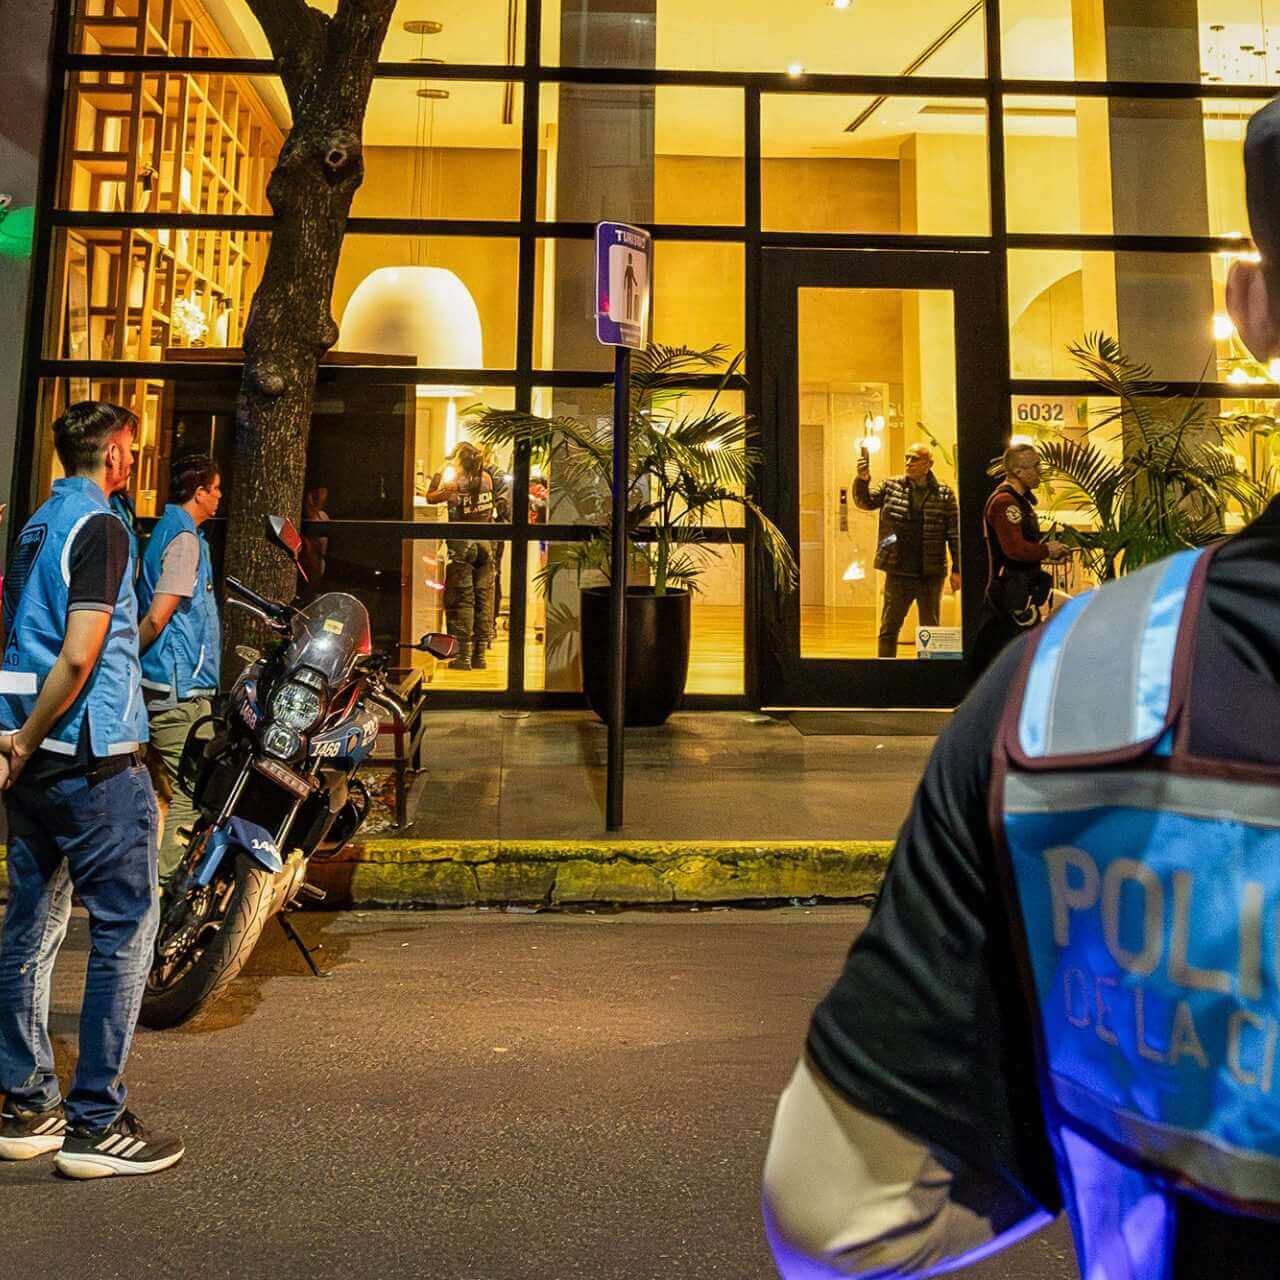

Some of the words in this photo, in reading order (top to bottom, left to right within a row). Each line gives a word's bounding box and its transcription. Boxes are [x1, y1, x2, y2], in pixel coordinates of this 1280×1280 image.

[1017, 403, 1064, 421] 6032
[1064, 968, 1119, 1047] DE
[1135, 984, 1210, 1068] LA
